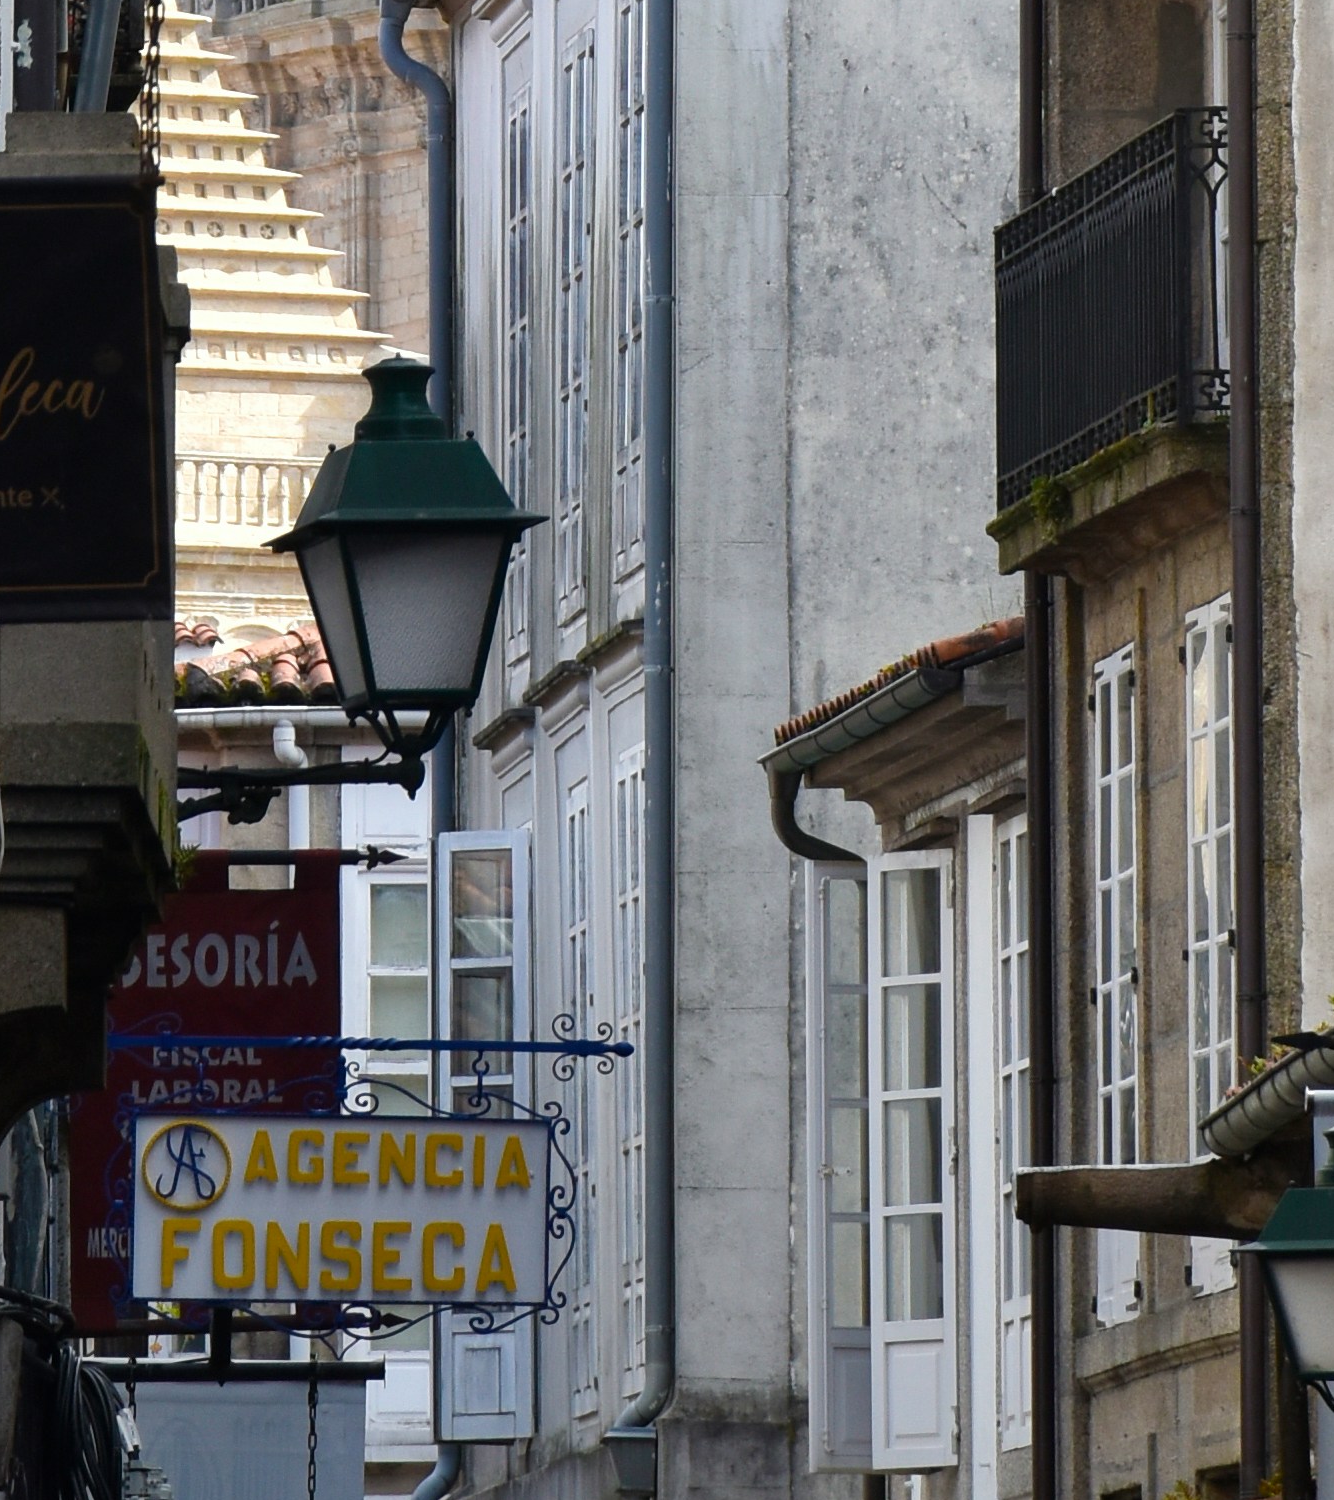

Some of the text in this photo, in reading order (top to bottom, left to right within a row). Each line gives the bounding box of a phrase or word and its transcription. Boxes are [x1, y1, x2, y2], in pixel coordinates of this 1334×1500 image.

[152, 1045, 263, 1067] FISCAL
[131, 1078, 283, 1105] LABORAL
[243, 1129, 532, 1189] AGENCIA
[160, 1218, 517, 1293] FONSECA
